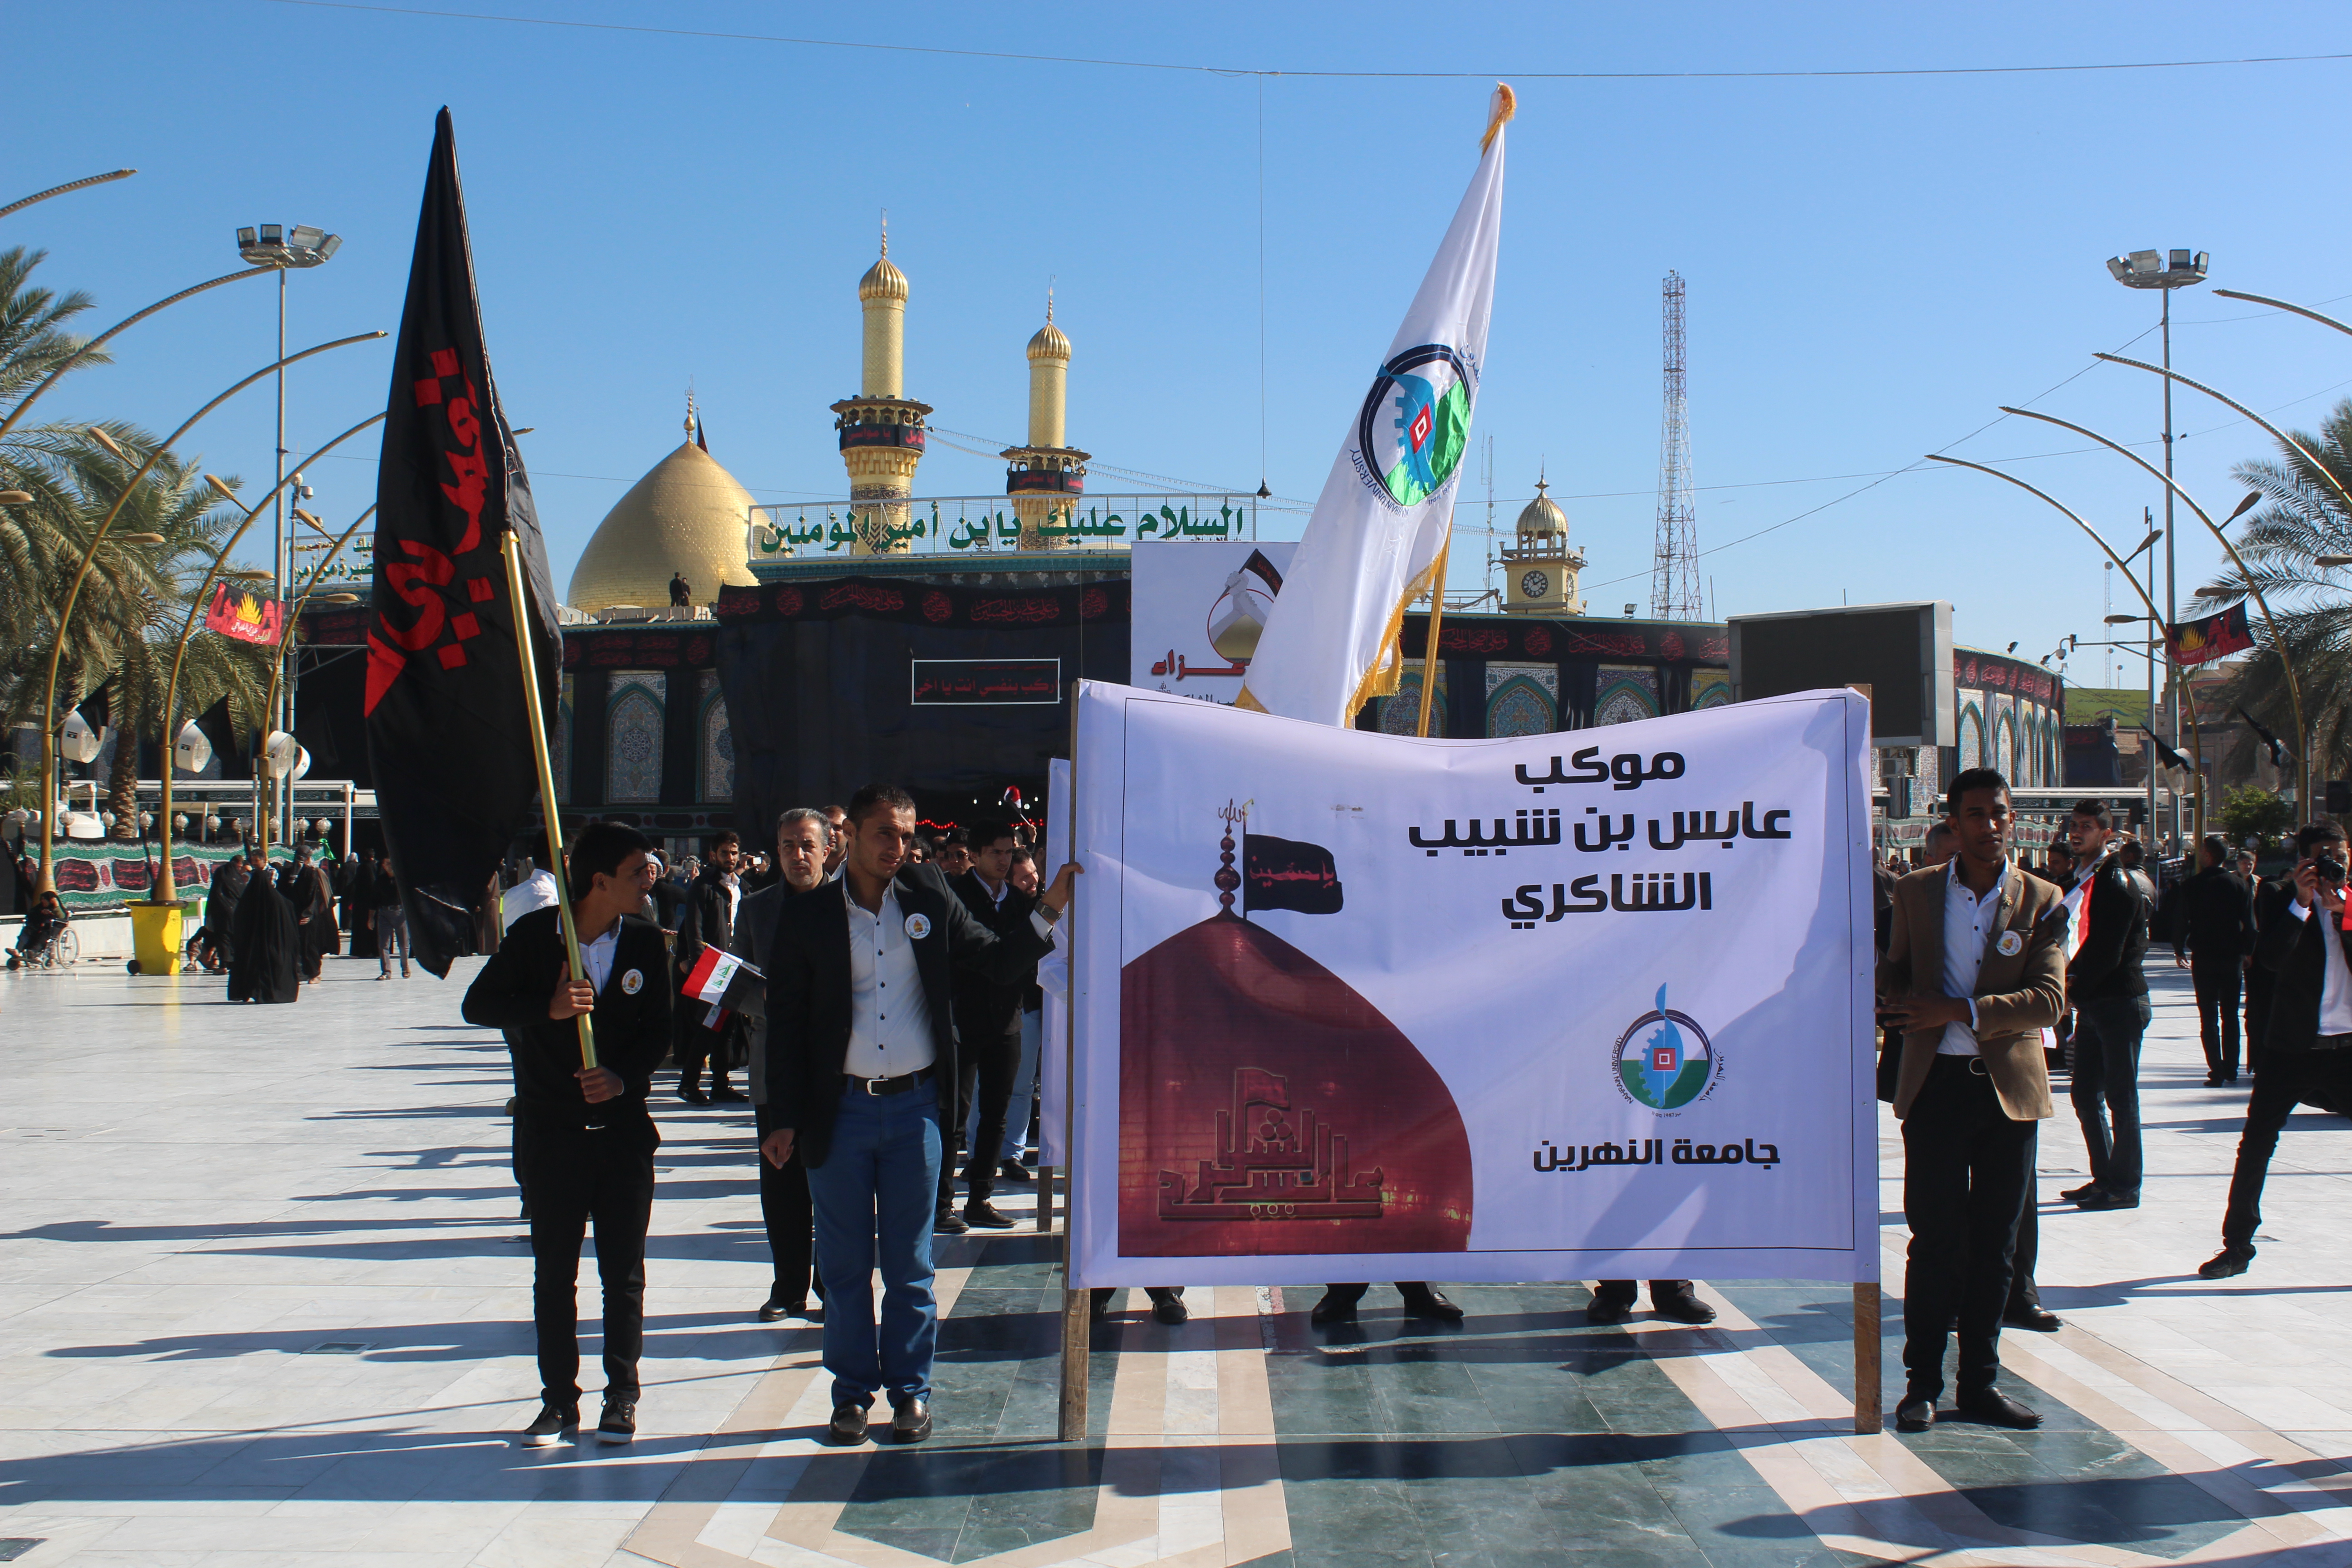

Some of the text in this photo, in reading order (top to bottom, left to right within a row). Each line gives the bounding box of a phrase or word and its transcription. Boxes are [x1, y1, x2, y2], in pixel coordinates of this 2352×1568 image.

[1349, 448, 1409, 516] NAHRAIN UNIVERSITY
[761, 510, 872, 554] المؤمنين
[879, 500, 939, 549] أمير
[1037, 505, 1127, 545] عليك
[1137, 504, 1243, 540] السلام
[820, 584, 860, 610] الحسين
[970, 599, 1015, 621] الحسين
[1568, 633, 1608, 654] الحسين
[1152, 649, 1246, 681] عزاء
[941, 679, 952, 696] يا
[979, 678, 1019, 697] بنفسي
[1514, 745, 1685, 794] موكب
[1408, 801, 1790, 857] عابس بن شبيب
[1249, 856, 1334, 888] يا حسين
[1501, 871, 1712, 930] الشاكري
[1612, 1034, 1634, 1104] NAHRAIN UNIVERSITY
[1698, 1048, 1726, 1101] جامعة النهرين
[1533, 1137, 1780, 1173] جامعة النهرين
